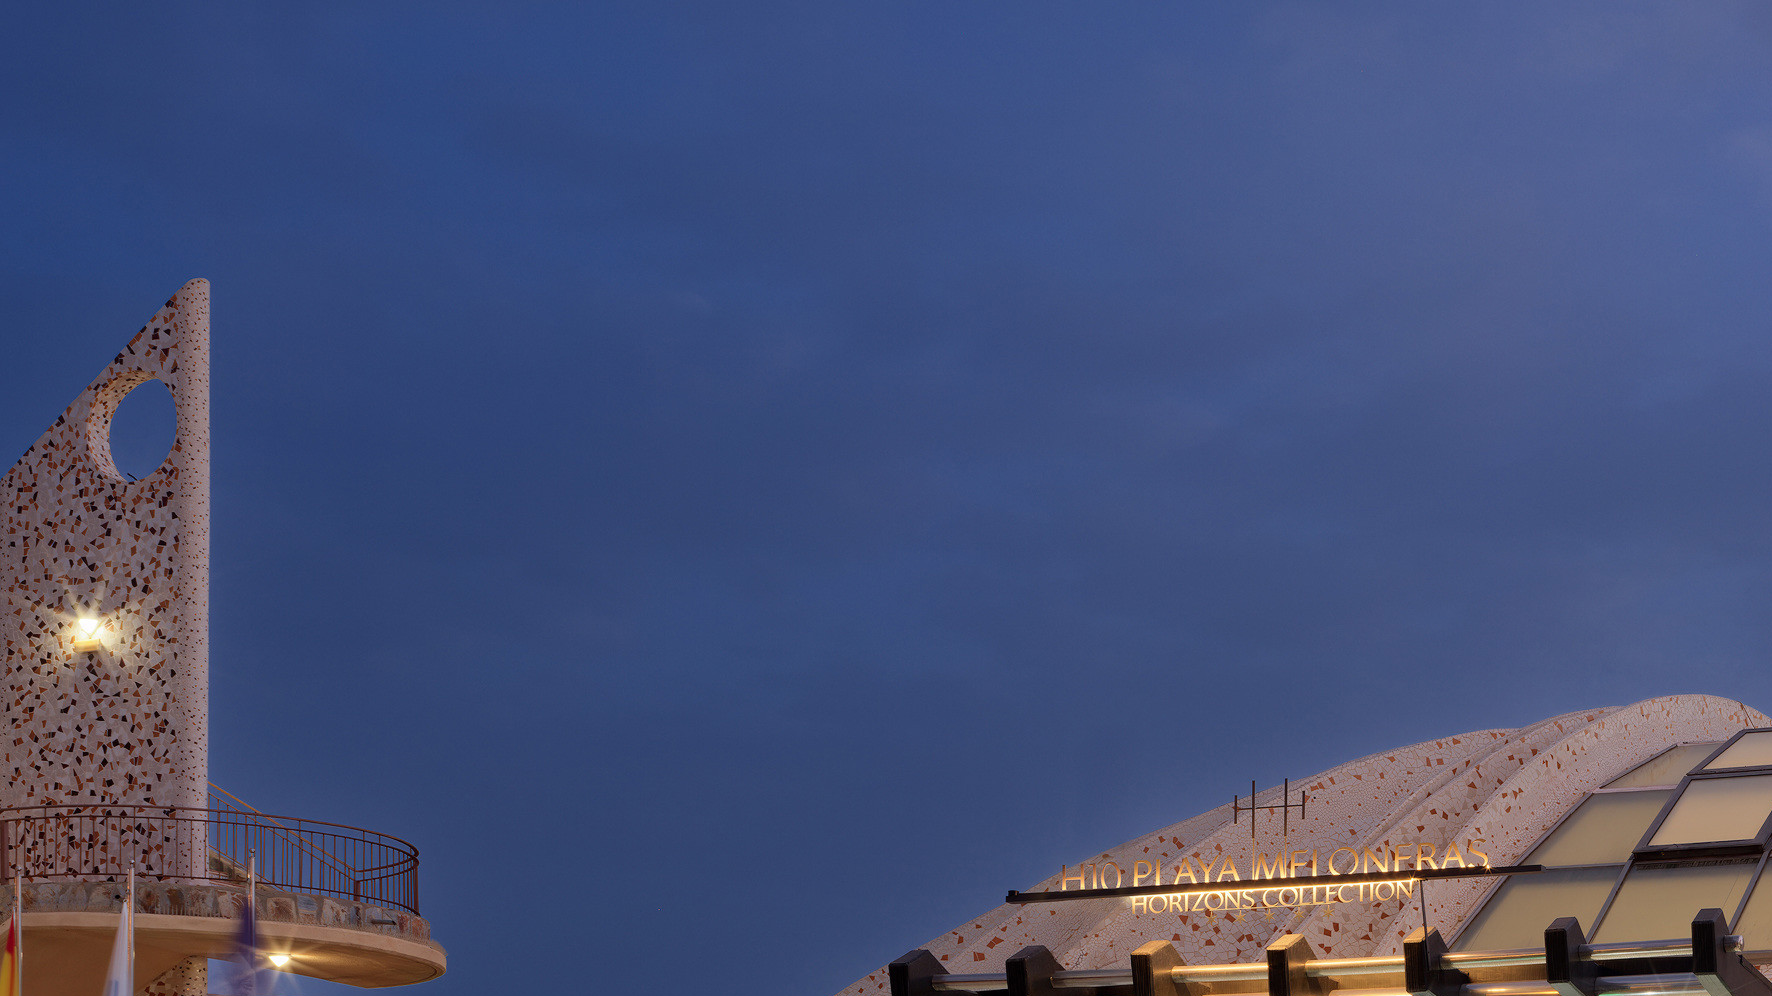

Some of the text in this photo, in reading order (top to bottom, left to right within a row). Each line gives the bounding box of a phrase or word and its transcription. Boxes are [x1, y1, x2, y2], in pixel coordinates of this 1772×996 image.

[1061, 862, 1122, 891] H10
[1132, 880, 1414, 915] HORIZONS COLLECTION
